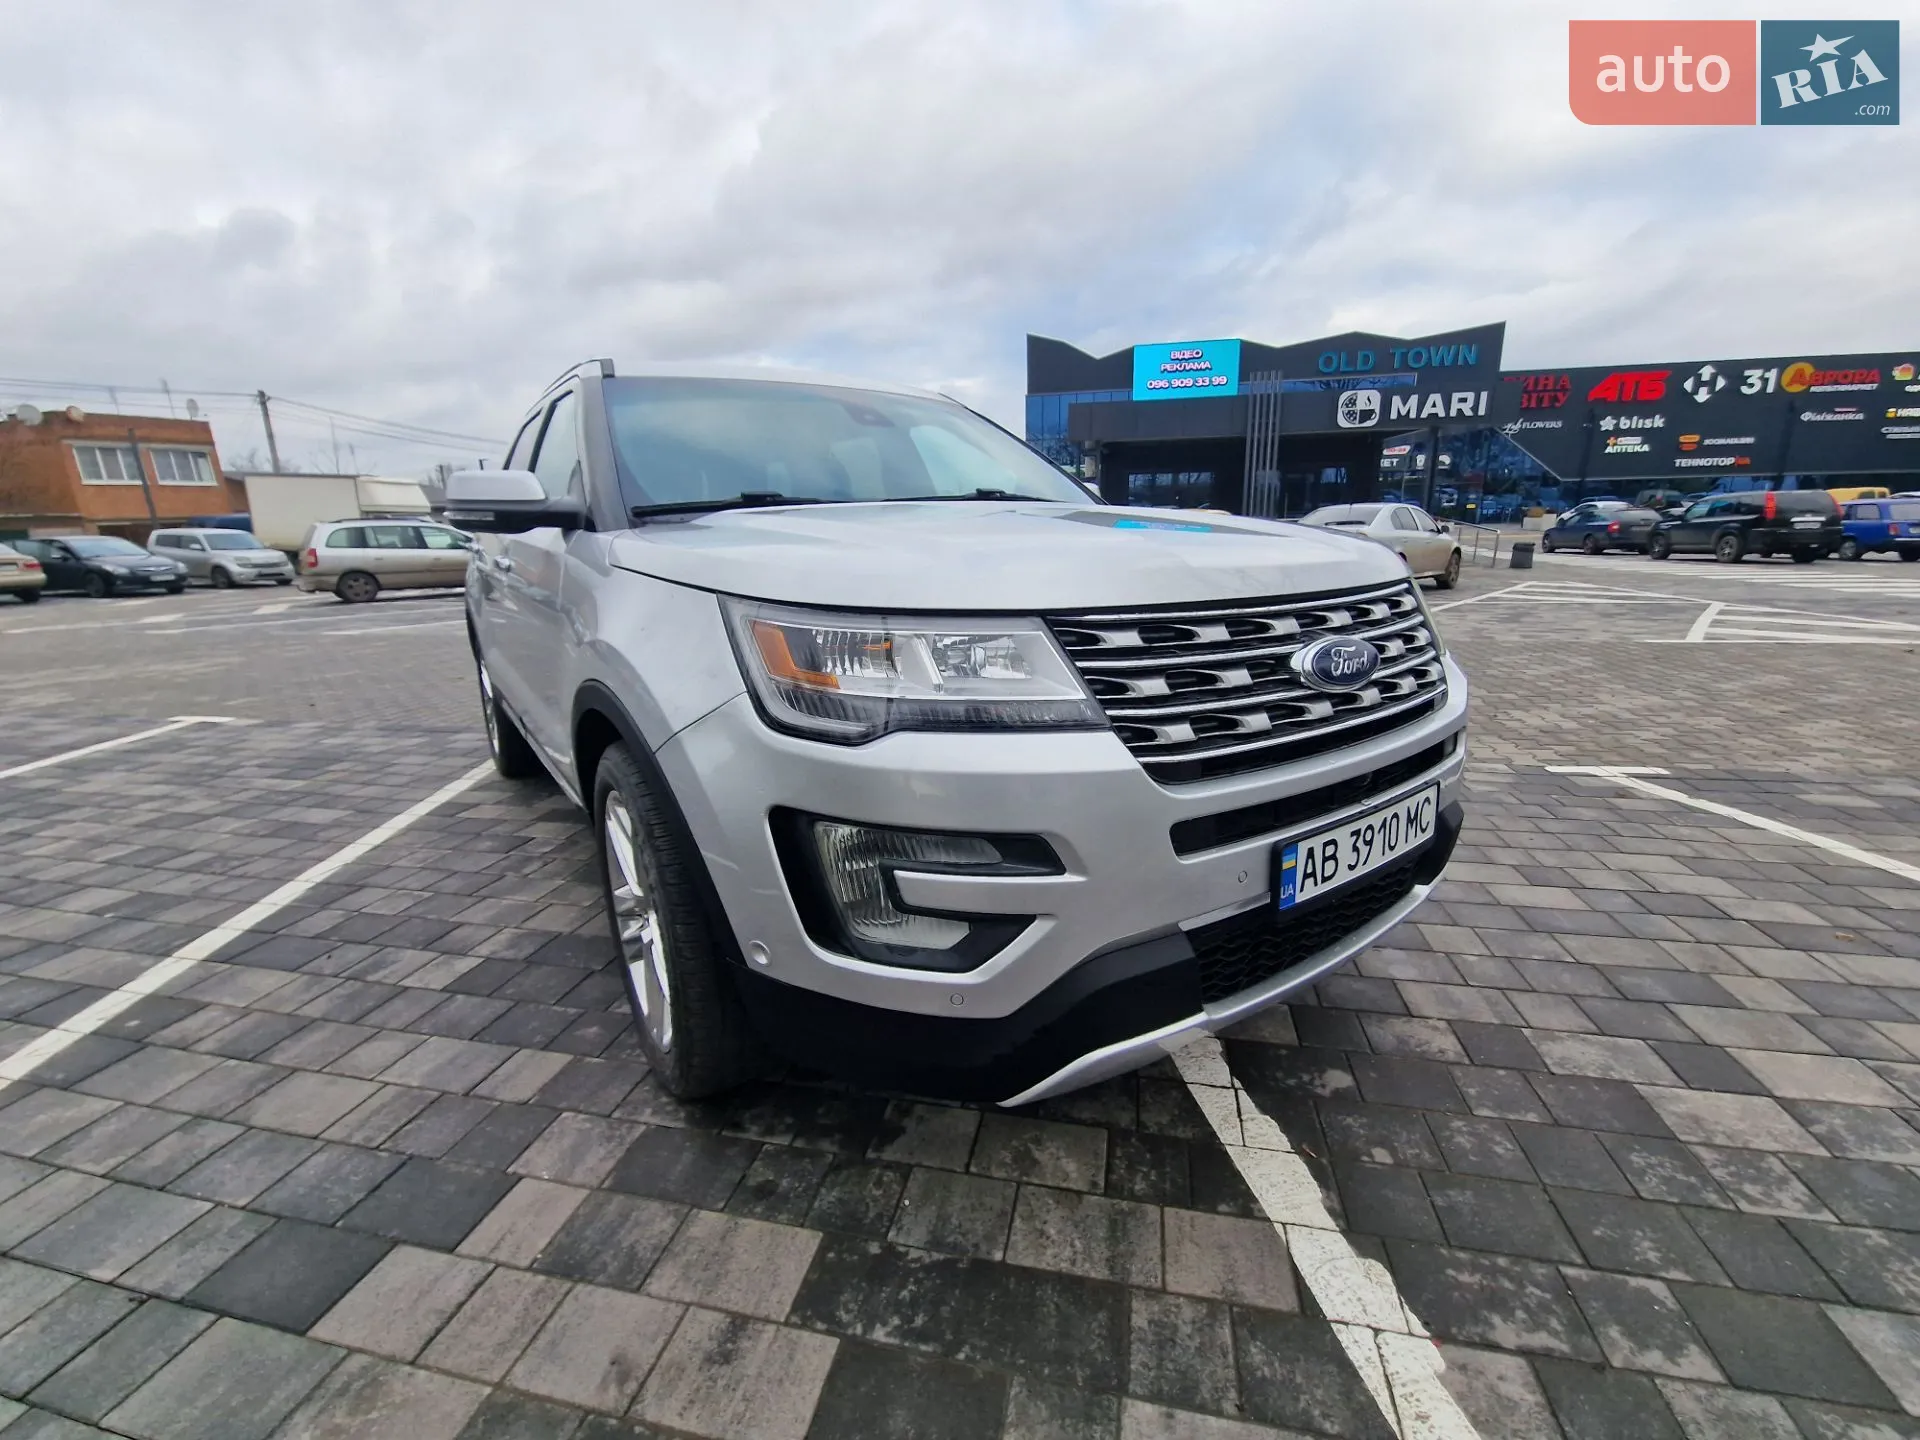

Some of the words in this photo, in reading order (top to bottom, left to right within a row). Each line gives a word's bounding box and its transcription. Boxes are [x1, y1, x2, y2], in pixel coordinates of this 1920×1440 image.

[1170, 349, 1203, 361] ВІДЕО
[1318, 350, 1376, 373] OLD
[1390, 344, 1479, 369] TOWN
[1160, 361, 1212, 373] РЕКЛАМА
[1146, 379, 1169, 389] 096
[1171, 378, 1193, 388] 909
[1195, 376, 1210, 386] 33
[1212, 375, 1228, 386] 99
[1588, 371, 1672, 401] АТБ
[1740, 368, 1778, 395] 31
[1389, 391, 1489, 420] MARI
[1522, 420, 1563, 429] FLOWERS
[1619, 415, 1665, 429] blisk
[1604, 444, 1650, 454] АПТЕКА
[1330, 646, 1370, 677] Ford
[1299, 836, 1339, 893] AB
[1347, 811, 1400, 871] 3910
[1405, 796, 1432, 844] MC
[1280, 885, 1294, 899] UA
